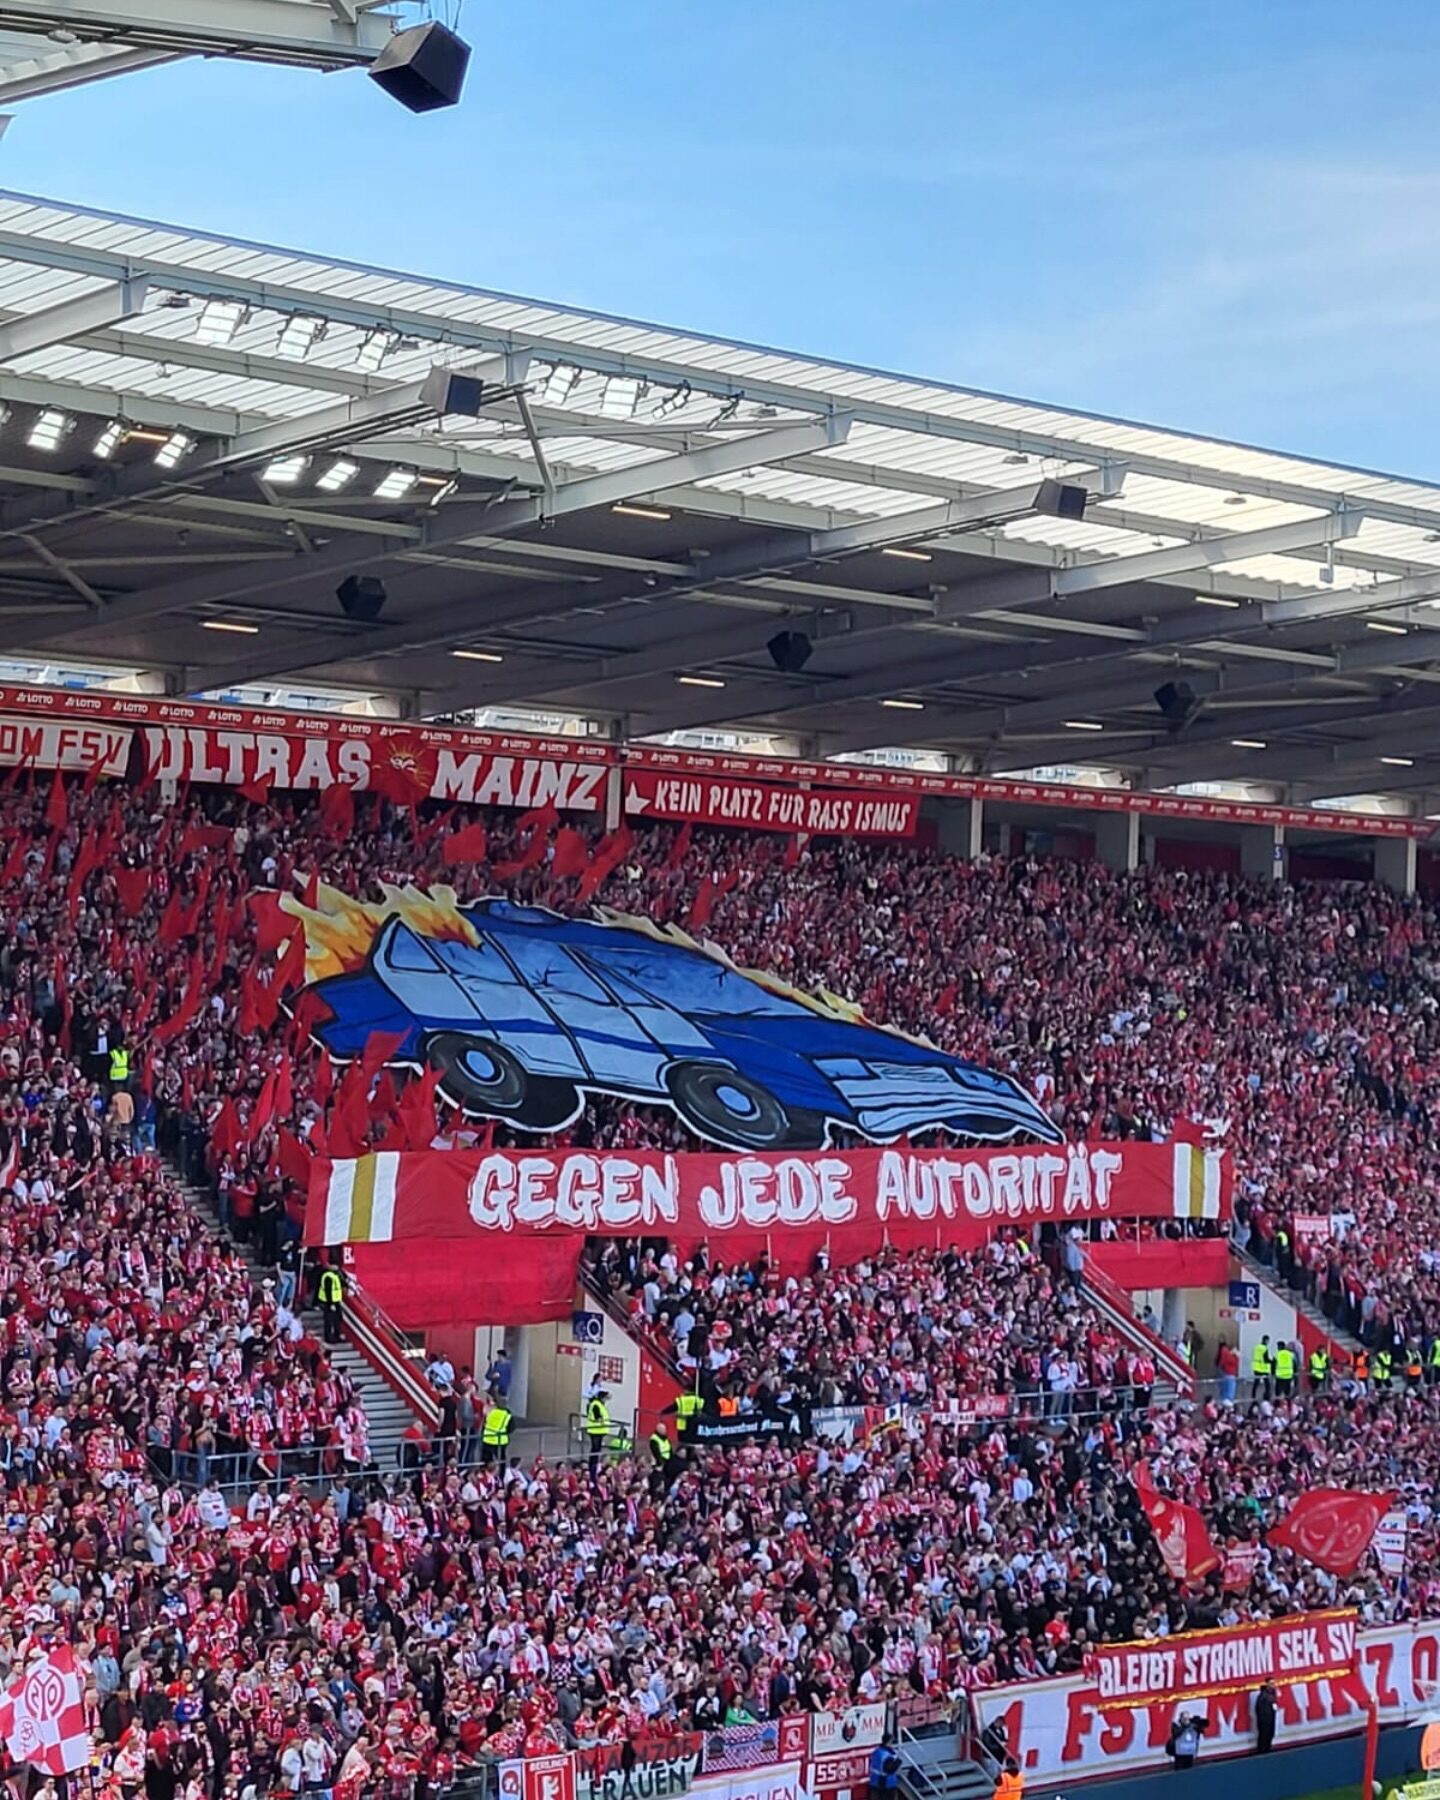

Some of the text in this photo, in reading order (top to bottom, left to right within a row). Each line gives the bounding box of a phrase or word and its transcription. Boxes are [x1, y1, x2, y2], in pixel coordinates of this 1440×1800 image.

[28, 695, 53, 704] LOTTO
[76, 698, 101, 708] LOTTO
[123, 702, 148, 713] LOTTO
[170, 707, 194, 717] LOTTO
[218, 712, 241, 721] LOTTO
[263, 716, 286, 726] LOTTO
[306, 720, 328, 730] LOTTO
[349, 724, 371, 734] LOTTO
[58, 729, 124, 764] FSV
[145, 727, 607, 811] ULTRAS MAINZ
[655, 780, 701, 815] KEIN
[709, 785, 763, 820] PLATZ
[807, 798, 852, 831] RASS
[854, 801, 911, 832] ISMUS
[469, 1143, 1123, 1231] GEGEN JEDE AUTORITÄT
[1246, 1286, 1257, 1305] R
[1098, 1650, 1176, 1698] BLEIBT
[1183, 1634, 1273, 1686] STRAMM
[1279, 1627, 1325, 1670] SEK.
[816, 1722, 835, 1737] MB
[862, 1715, 884, 1731] MM
[1062, 1688, 1177, 1761] FSV
[581, 1738, 694, 1780] MANZ05
[590, 1764, 687, 1800] FRAUEN
